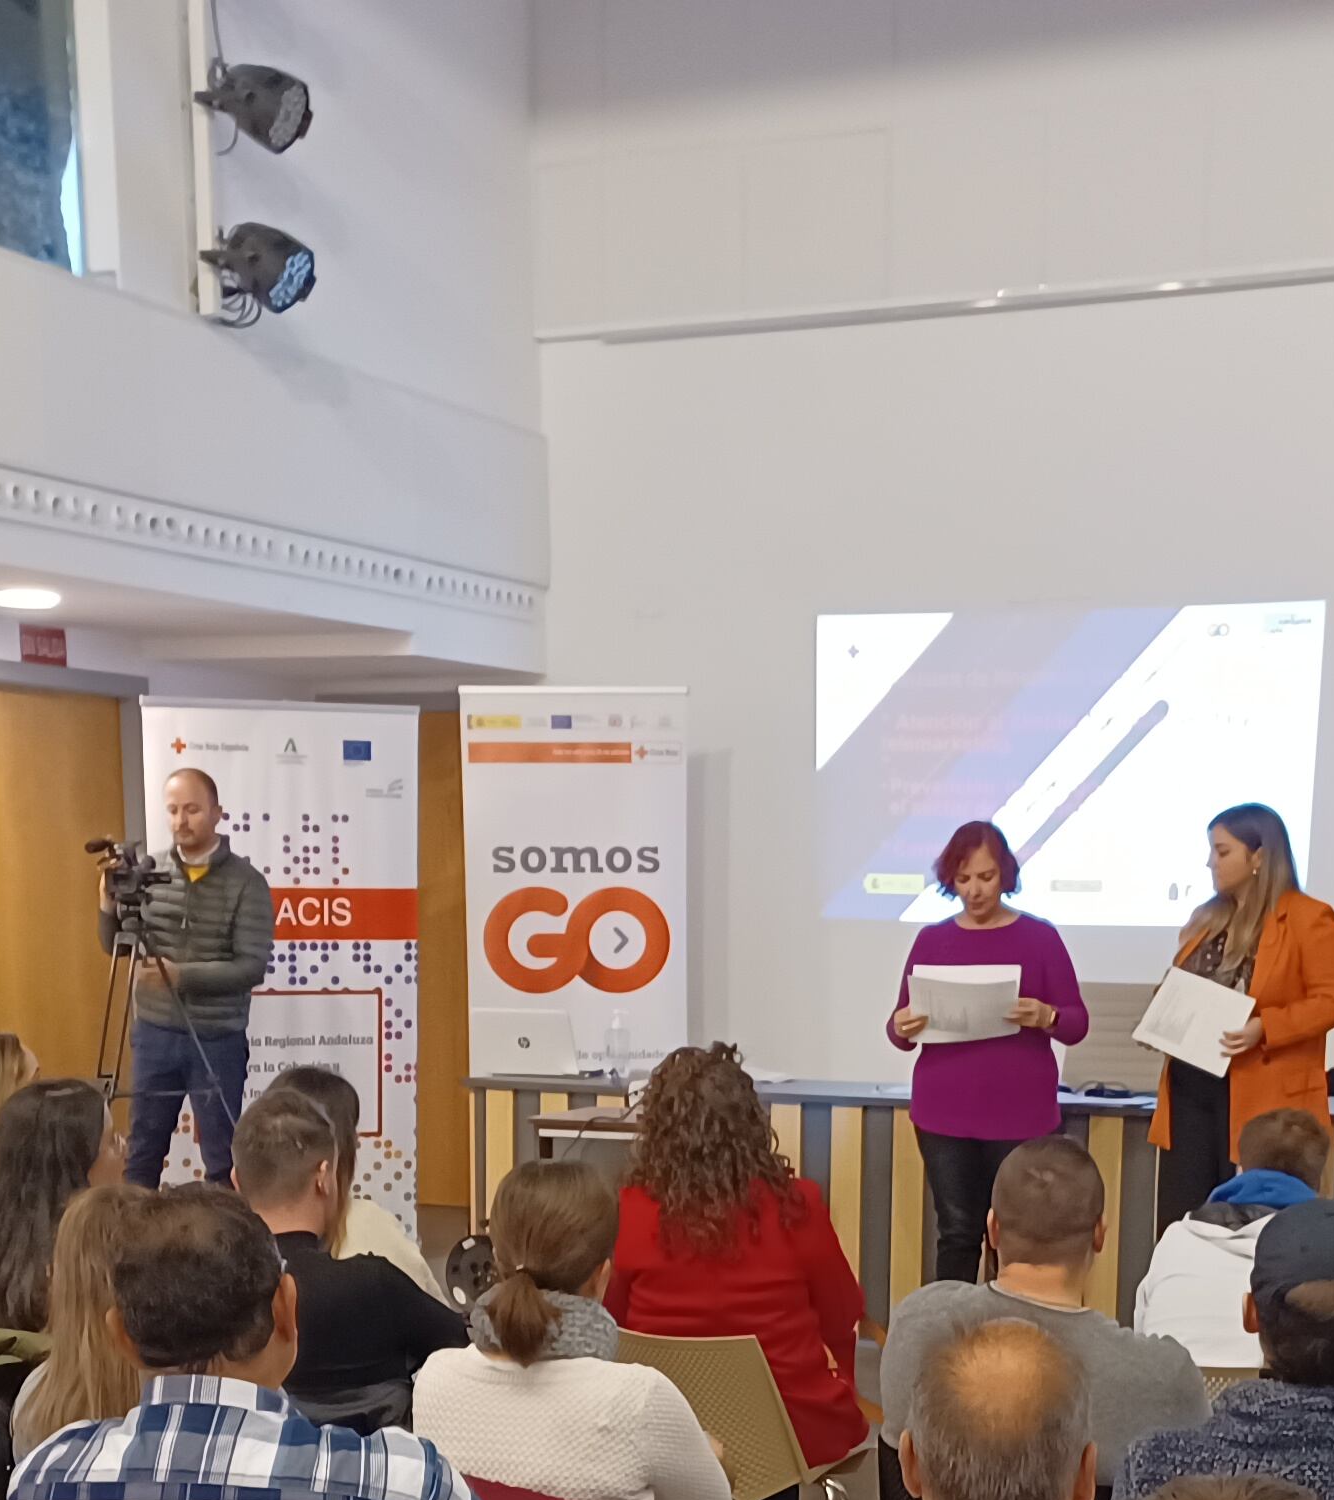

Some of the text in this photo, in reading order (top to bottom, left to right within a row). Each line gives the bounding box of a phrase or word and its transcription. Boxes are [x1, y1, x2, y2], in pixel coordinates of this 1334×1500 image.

[491, 845, 661, 874] somos
[274, 896, 352, 927] ACIS
[483, 886, 671, 994] GO
[264, 1035, 316, 1049] Regional
[318, 1034, 374, 1046] Andaluza
